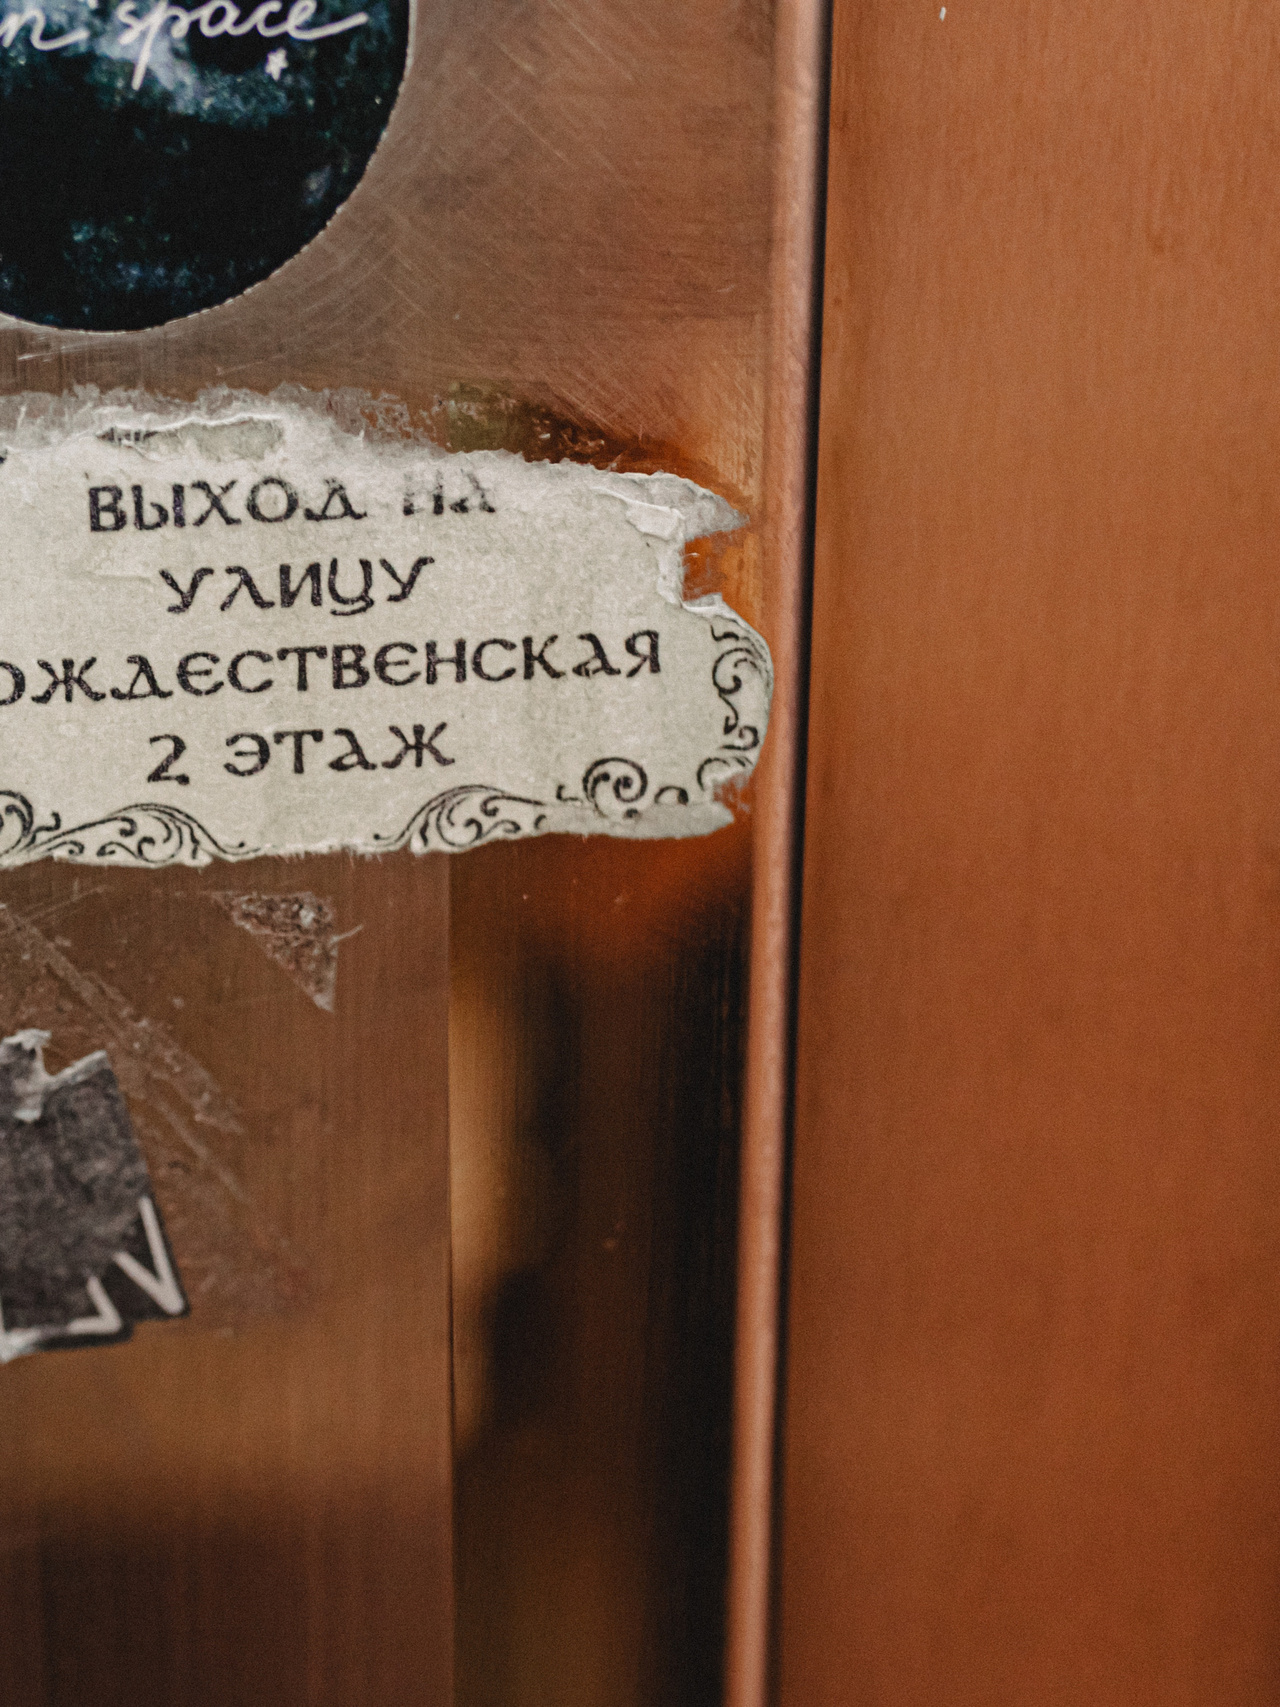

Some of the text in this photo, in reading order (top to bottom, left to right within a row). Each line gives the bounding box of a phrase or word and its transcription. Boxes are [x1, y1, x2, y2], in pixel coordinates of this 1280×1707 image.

[116, 0, 370, 91] space
[87, 476, 368, 533] ВЫХОД
[159, 556, 436, 617] УЛИЦУ
[146, 721, 457, 786] 2 ЭТАЖ
